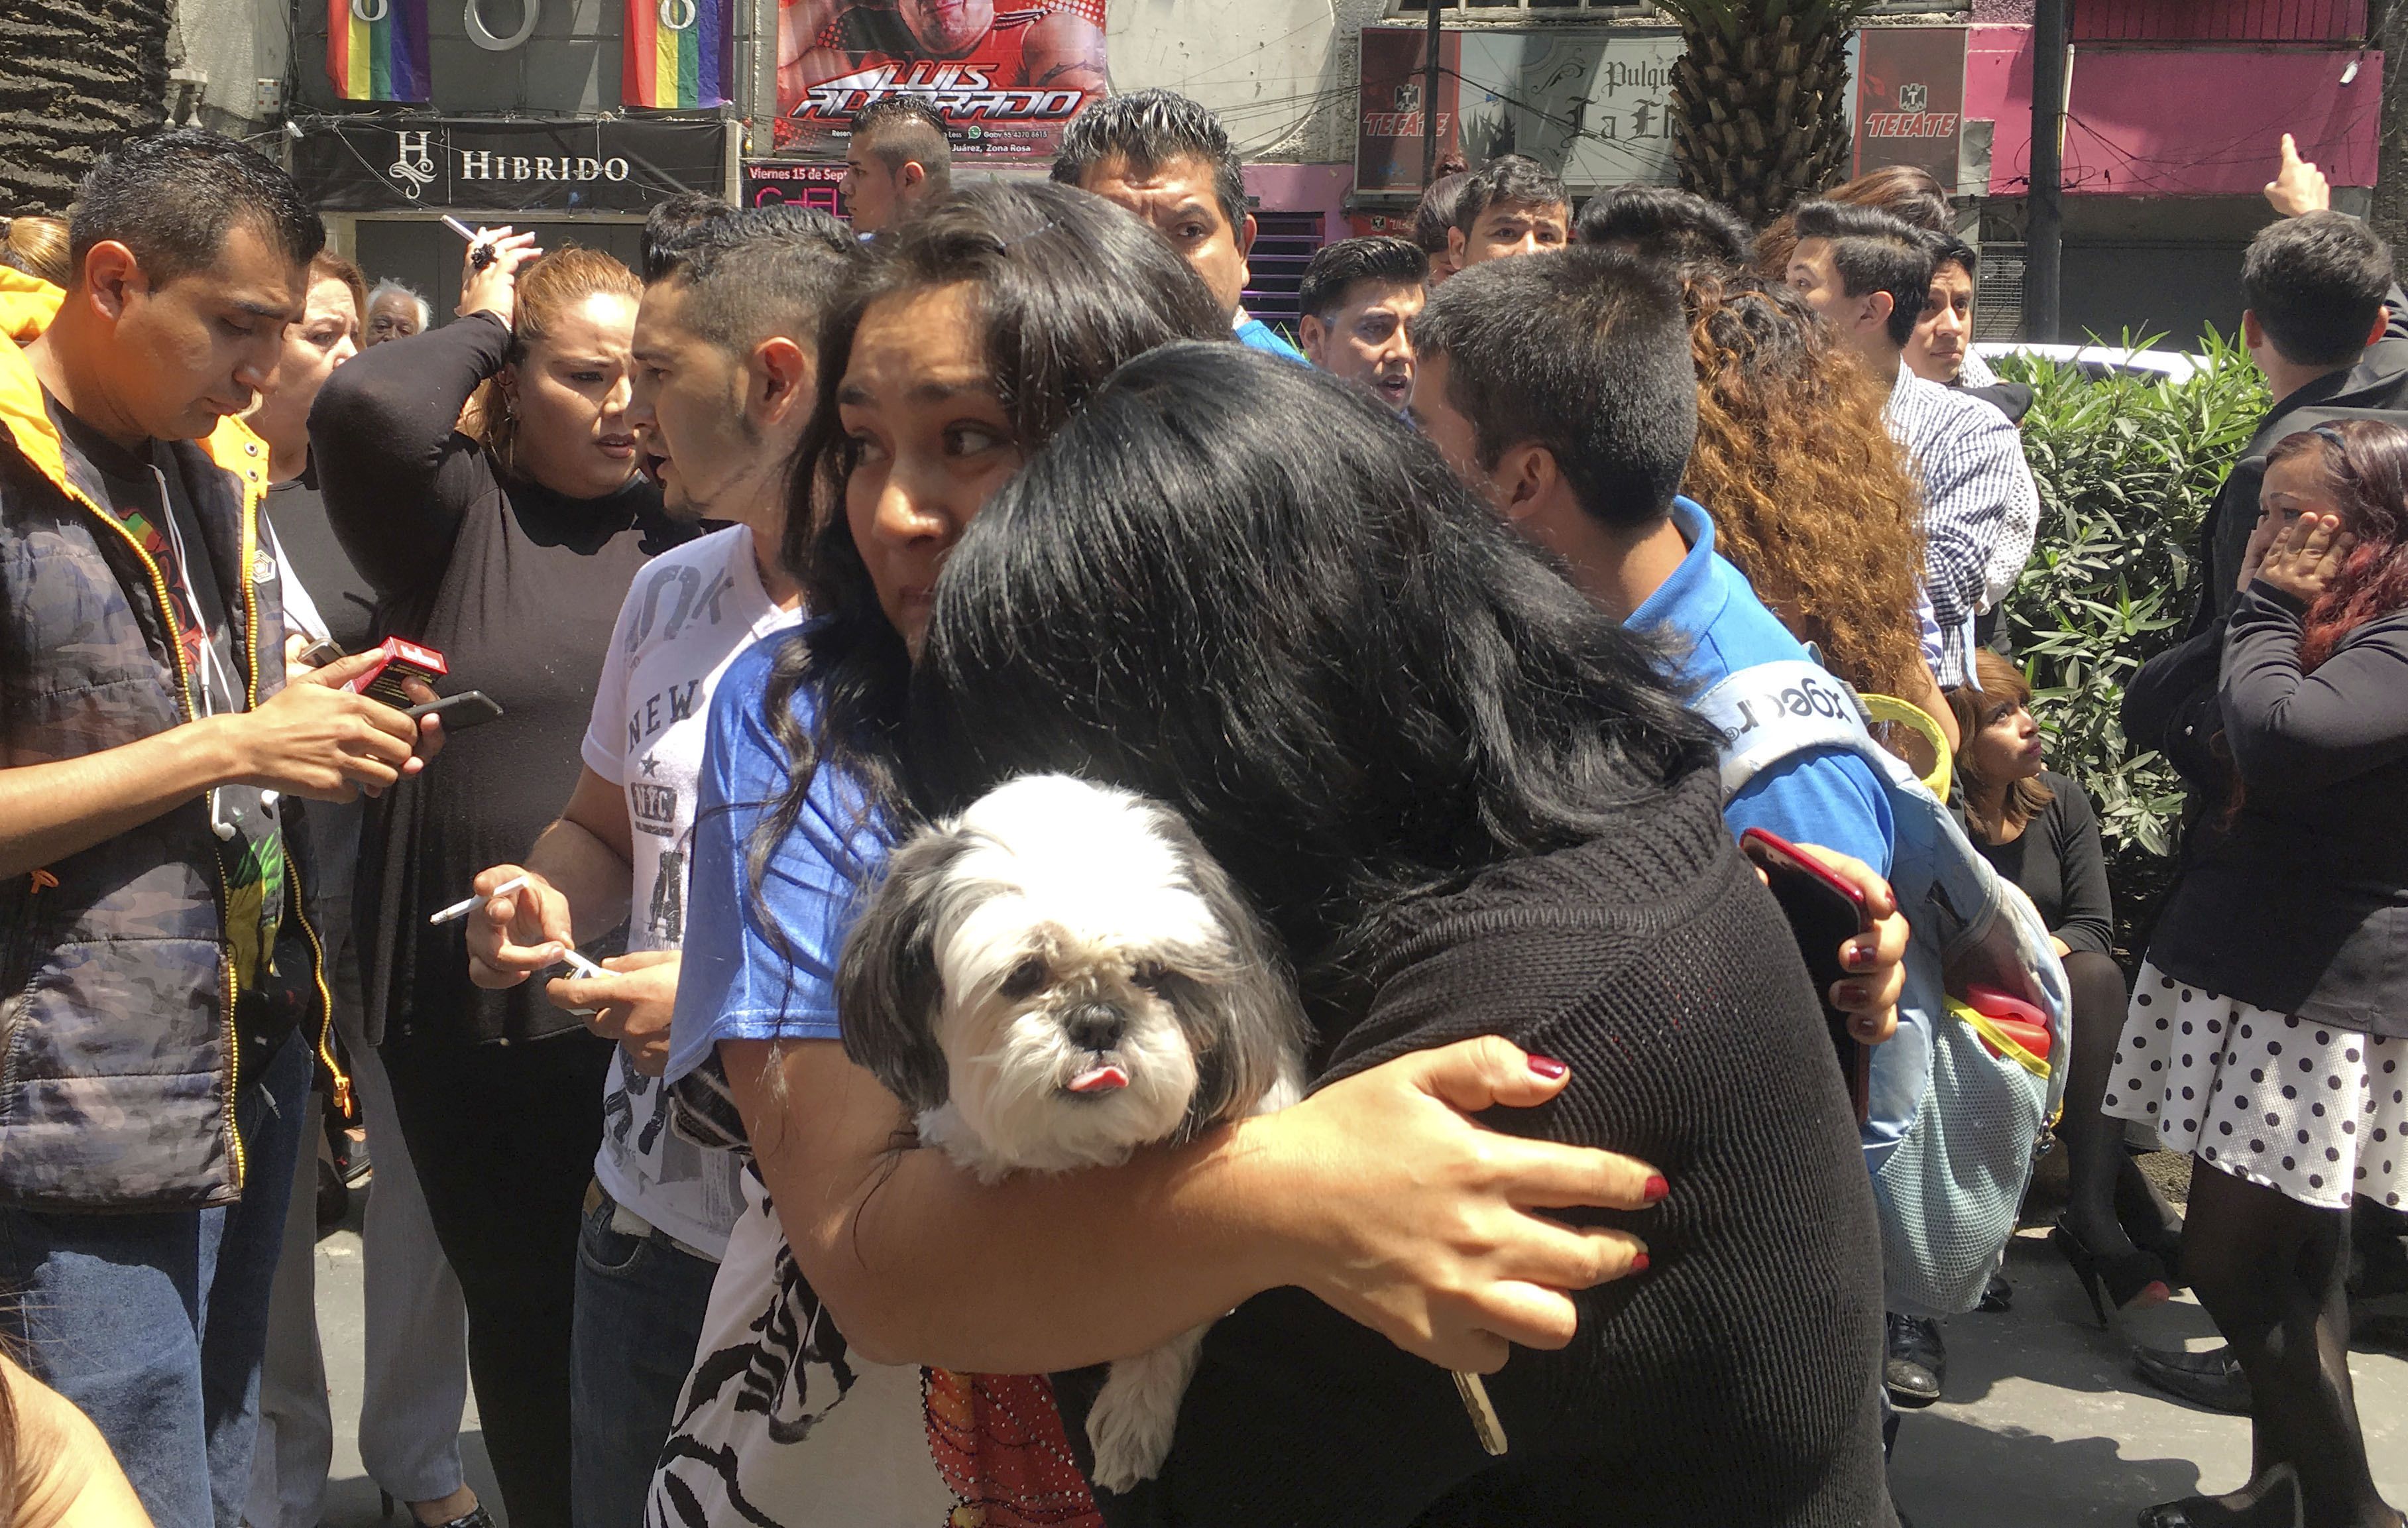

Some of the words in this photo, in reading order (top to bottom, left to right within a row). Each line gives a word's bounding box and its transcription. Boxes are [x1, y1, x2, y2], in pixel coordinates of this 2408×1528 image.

[868, 64, 997, 90] LUIS
[792, 89, 1082, 117] ALRADO
[1562, 95, 1617, 148] La
[1865, 111, 1958, 137] TECATE
[952, 144, 982, 153] Juárez,
[461, 150, 629, 182] HIBRIDO
[750, 167, 790, 180] Viernes
[792, 168, 805, 180] 15
[808, 168, 821, 180] de
[629, 679, 699, 754] NEW
[634, 785, 669, 819] NYC
